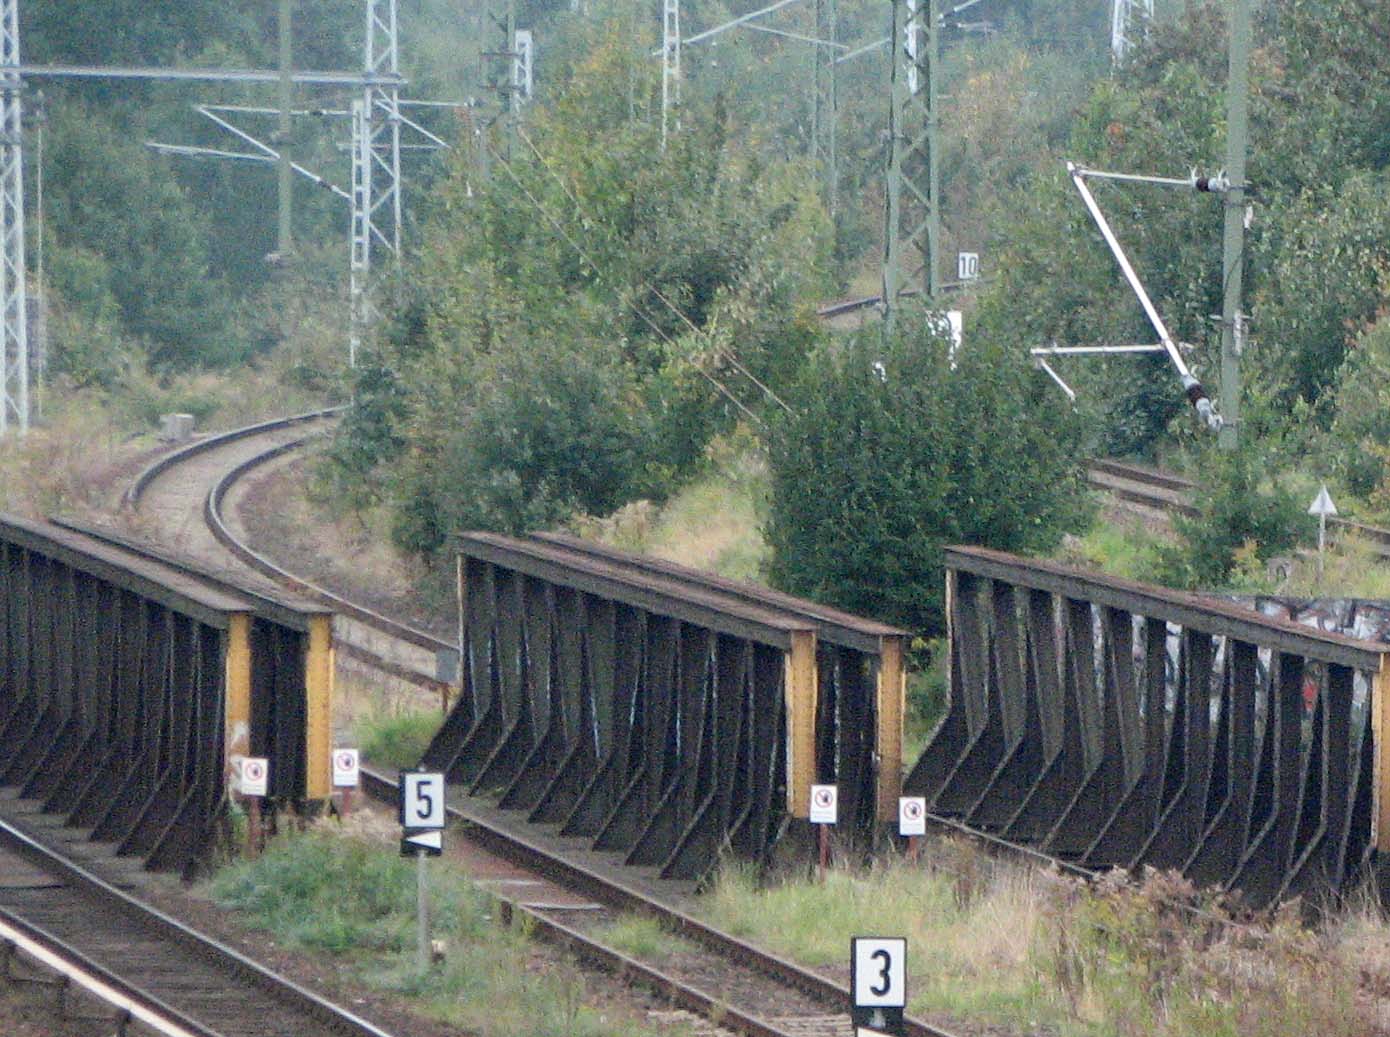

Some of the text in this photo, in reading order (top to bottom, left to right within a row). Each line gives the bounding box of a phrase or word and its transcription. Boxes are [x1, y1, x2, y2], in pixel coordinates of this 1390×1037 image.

[960, 256, 977, 276] 10
[416, 780, 432, 819] 5
[869, 949, 891, 997] 3
